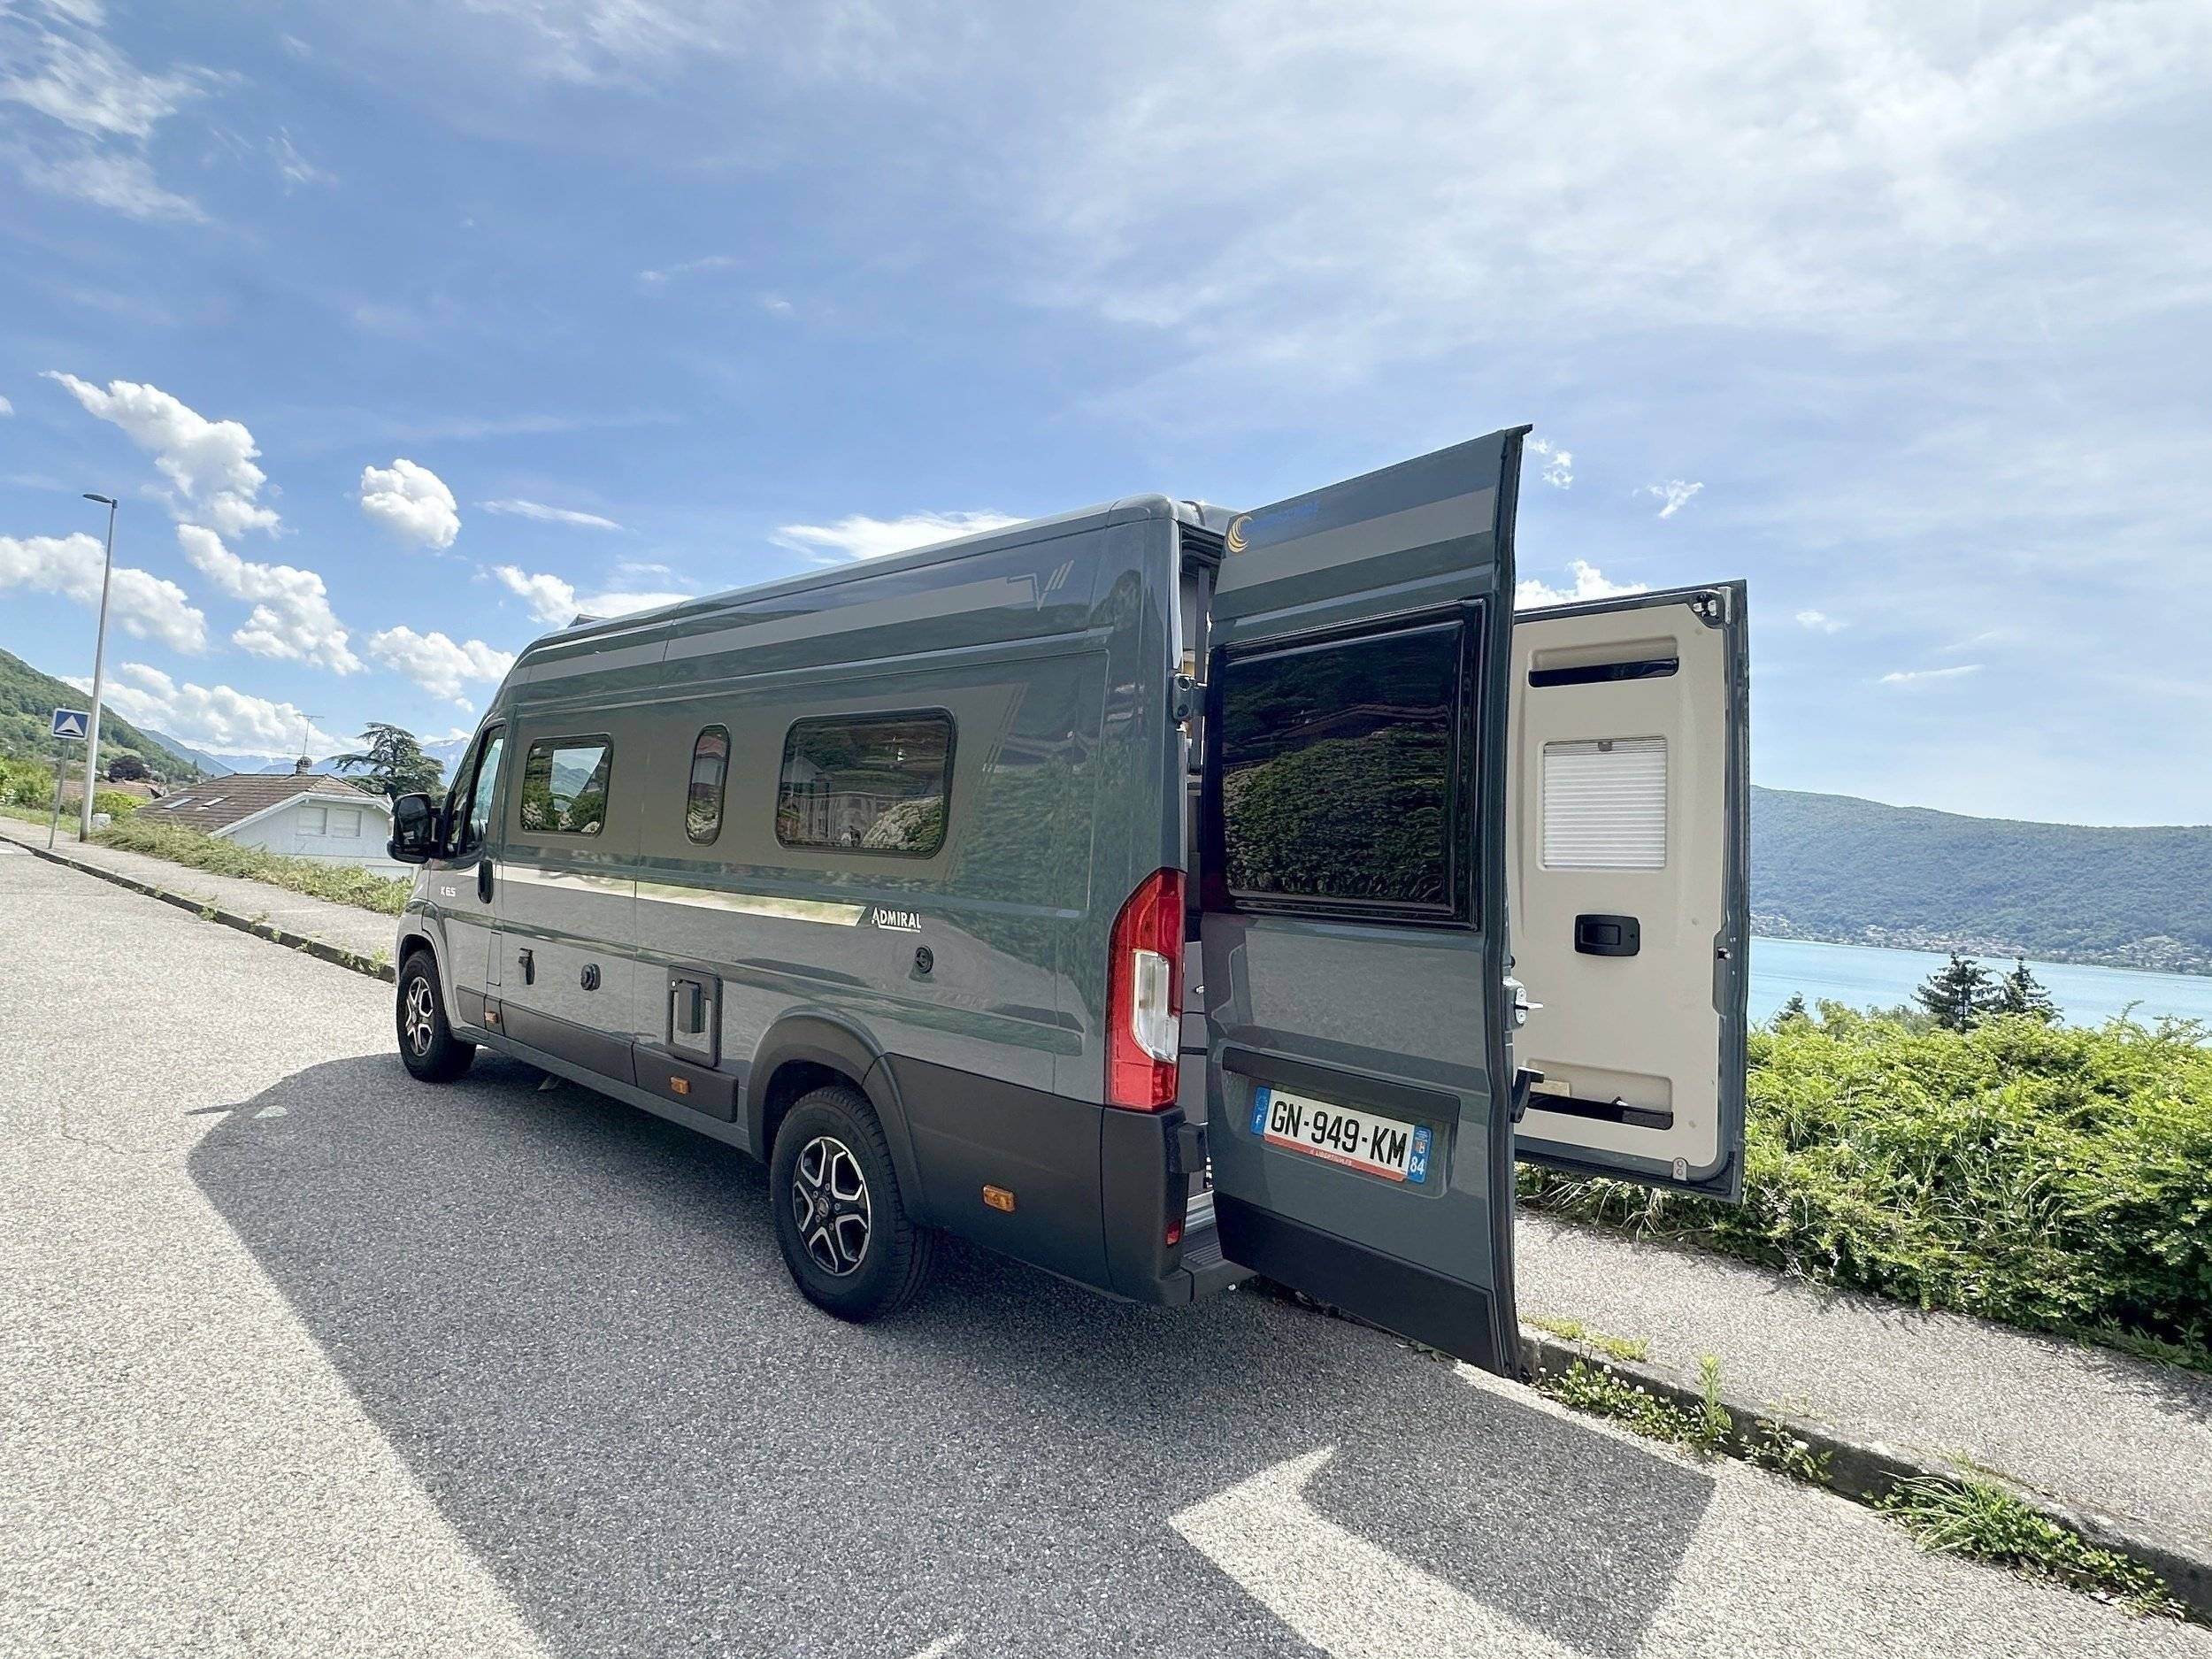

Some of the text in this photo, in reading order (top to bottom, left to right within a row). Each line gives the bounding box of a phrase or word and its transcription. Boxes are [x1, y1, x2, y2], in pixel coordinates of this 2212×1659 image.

[872, 907, 921, 929] ADMIRAL
[1256, 1115, 1263, 1125] F
[1271, 1101, 1408, 1168] GN-949-KM
[1410, 1156, 1425, 1175] 84
